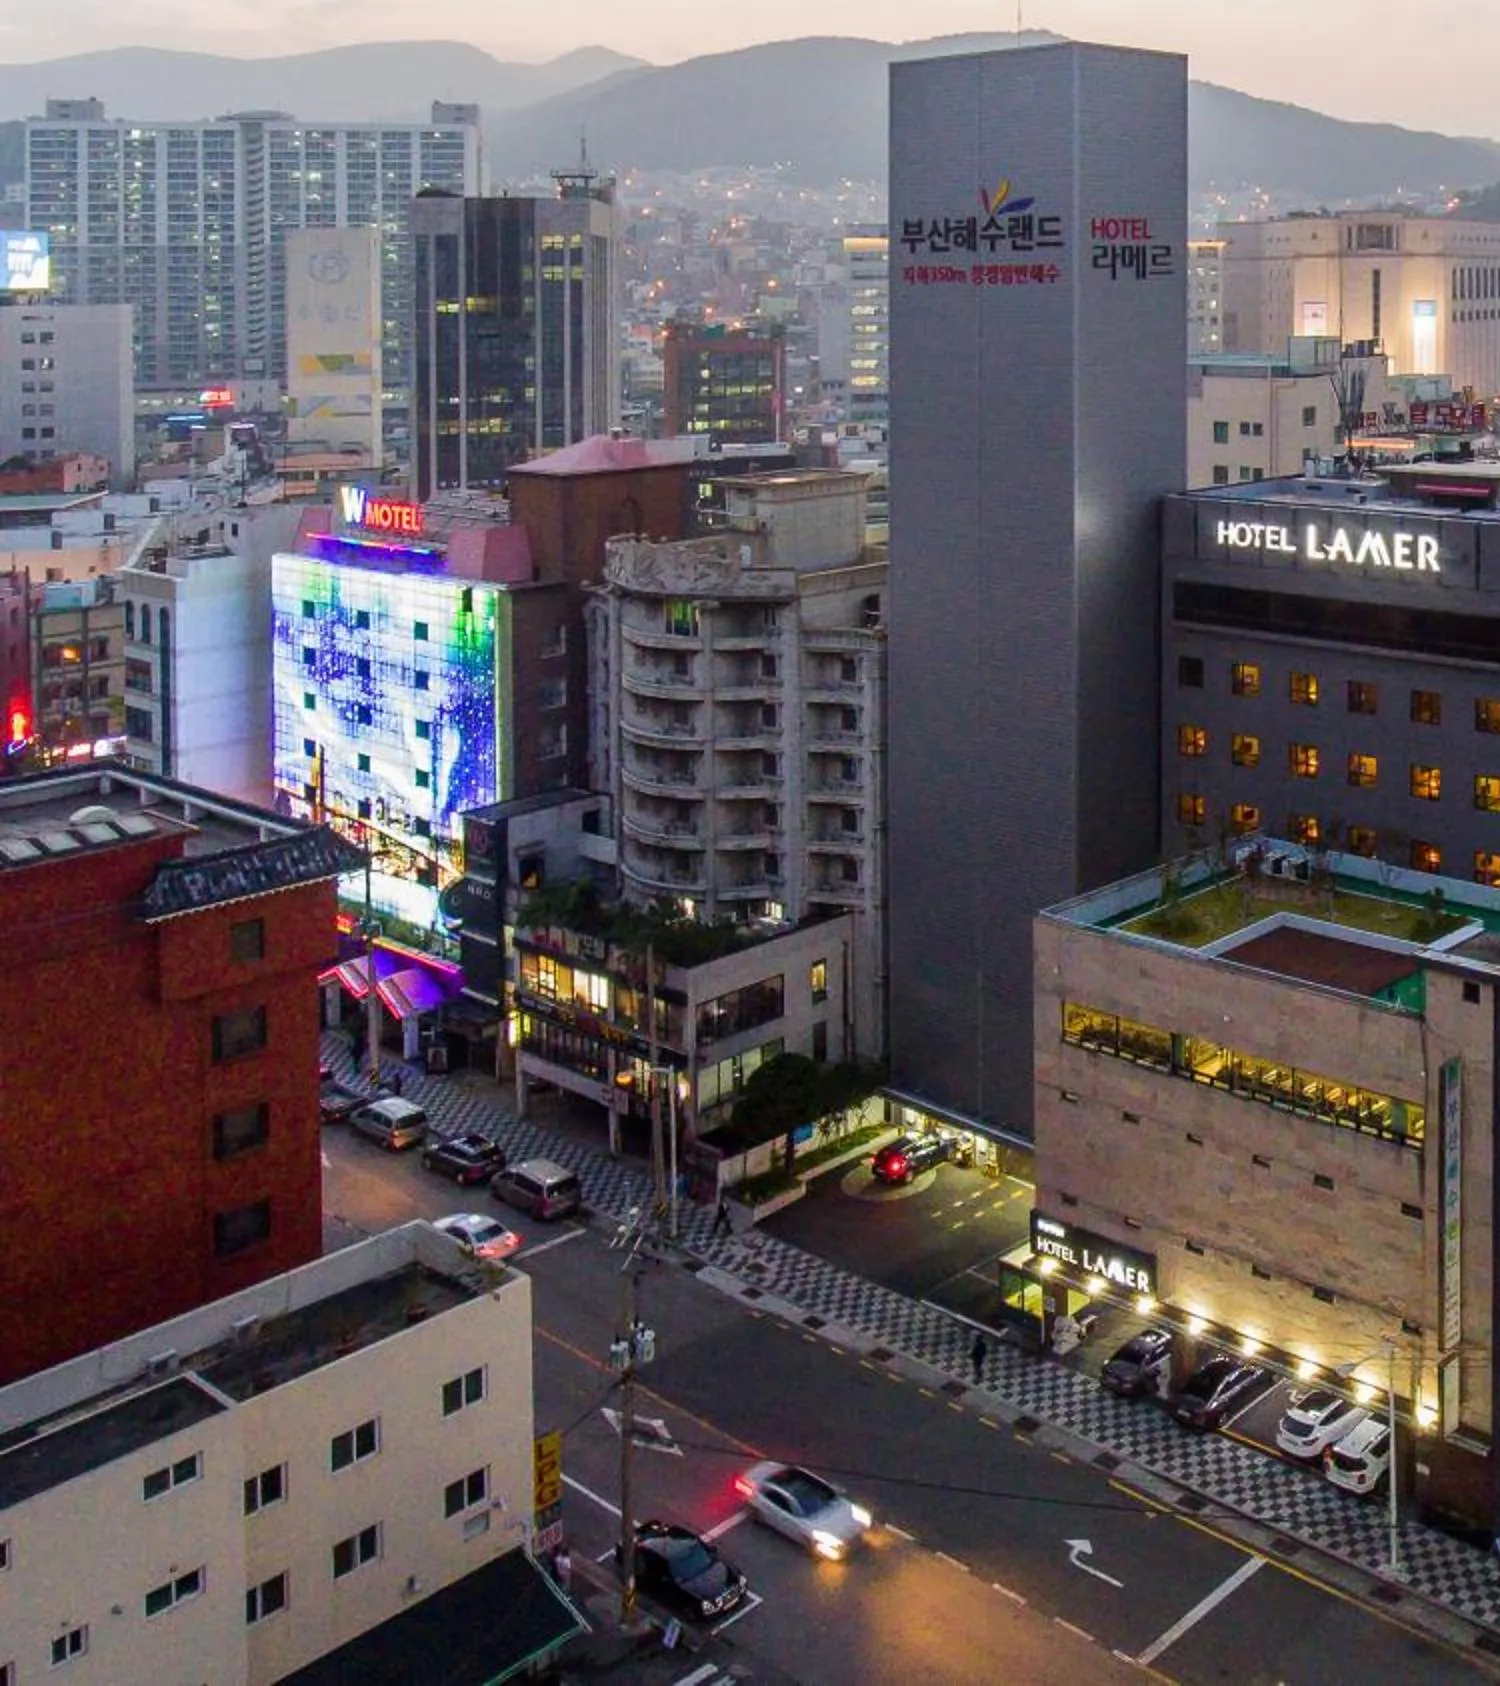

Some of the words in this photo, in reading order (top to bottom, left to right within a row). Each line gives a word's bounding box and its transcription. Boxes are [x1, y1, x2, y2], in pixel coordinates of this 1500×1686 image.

[901, 214, 1064, 253] 부산해수랜드
[1091, 218, 1153, 240] HOTEL
[1092, 245, 1174, 280] 라메르
[341, 486, 366, 524] W
[366, 500, 421, 532] MOTEL
[1216, 521, 1297, 552] HOTEL
[1307, 524, 1441, 572] LAMER
[1037, 1236, 1079, 1265] HOTEL
[1083, 1249, 1150, 1293] LAMER
